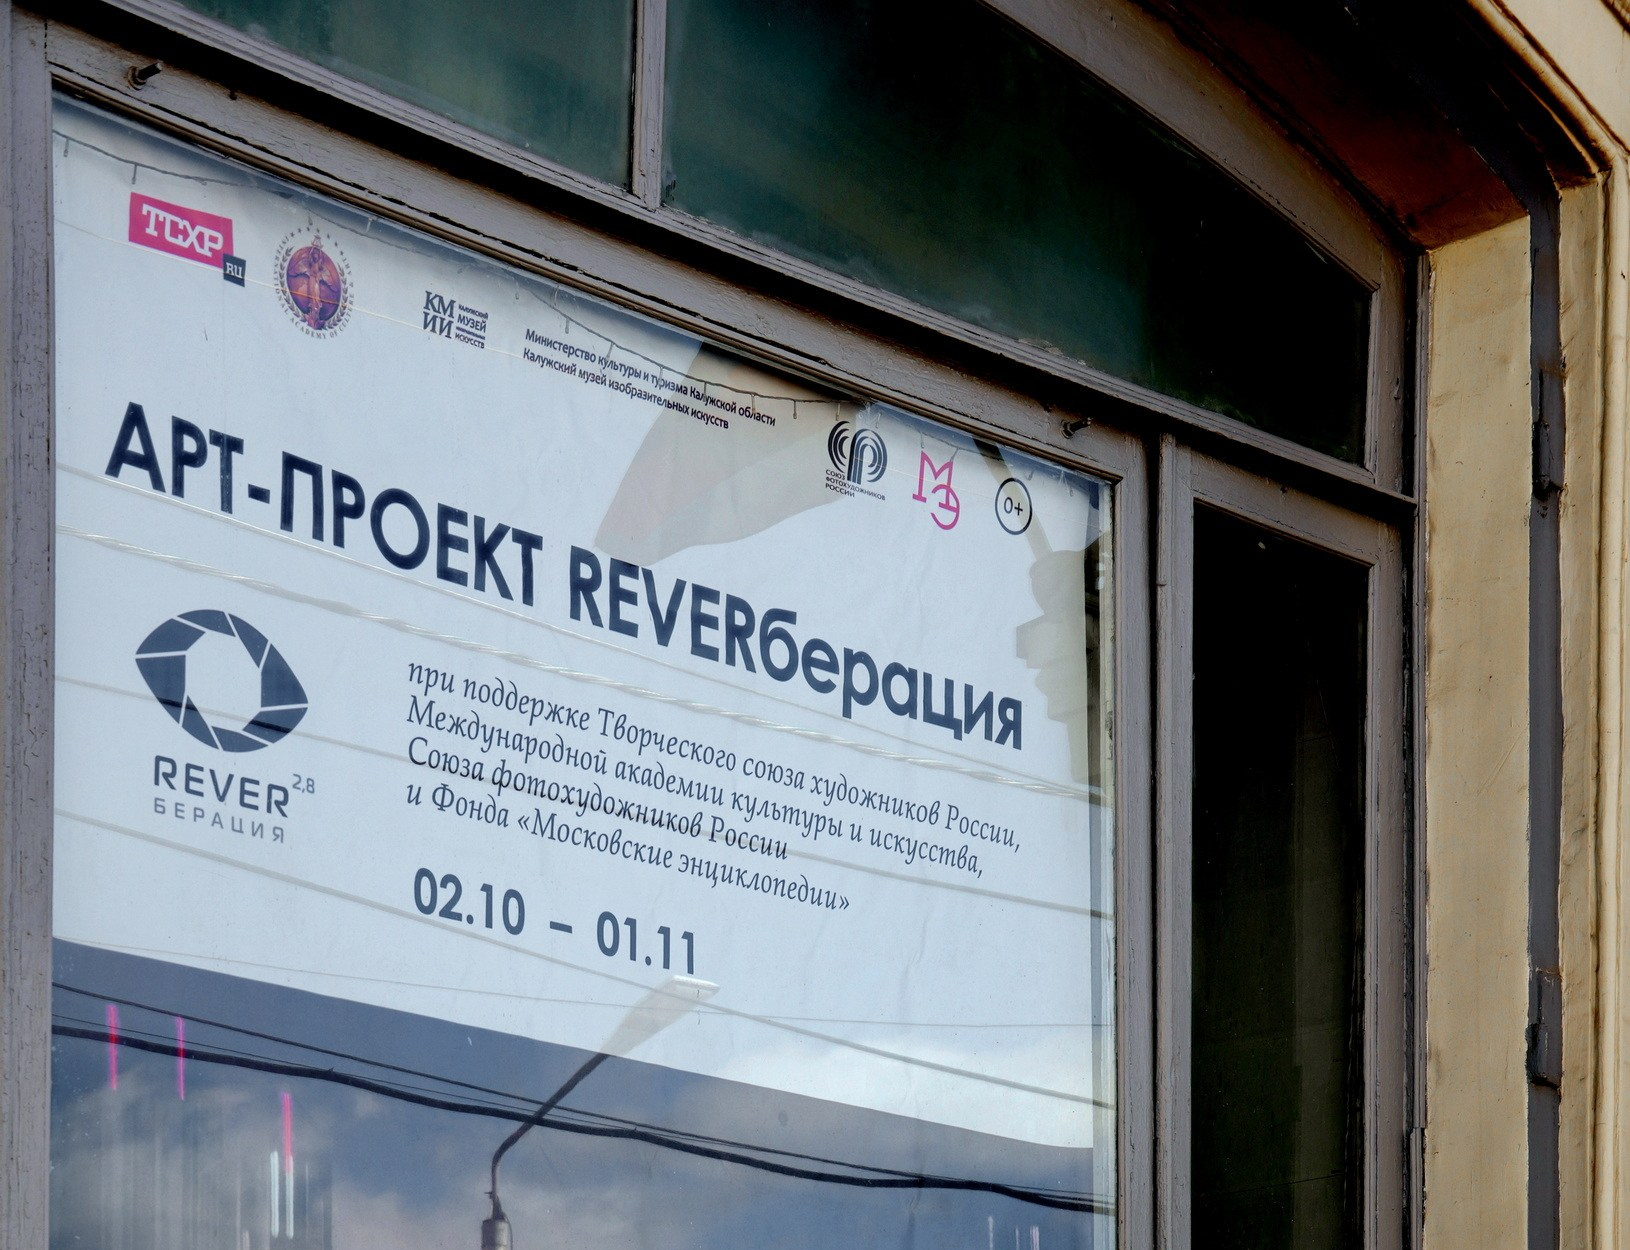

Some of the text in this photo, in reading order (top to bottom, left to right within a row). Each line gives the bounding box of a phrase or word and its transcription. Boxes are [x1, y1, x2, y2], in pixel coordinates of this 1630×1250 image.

[226, 262, 242, 279] RU
[423, 290, 456, 319] КМ
[457, 314, 487, 333] МУЗЕЙ
[289, 317, 327, 340] ACADEMY
[423, 311, 454, 339] ИИ
[455, 332, 485, 349] ИСКУССТВ
[523, 347, 729, 430] Калужский музей изобразительных искусств
[525, 328, 776, 427] Министерство культуры и туризма Калужской области
[825, 469, 846, 481] СОЮЗ
[825, 476, 886, 501] ФОТОХУДОЖНИКОВ
[825, 483, 855, 497] РОССИИ
[1003, 496, 1024, 517] 0+
[104, 401, 1022, 750] АРТ-ПРОЕКТ REVERберация
[408, 662, 1021, 853] при поддержке Творческого союза художников России,
[154, 755, 315, 818] REVER 2,8
[406, 695, 984, 878] Международной академии культуры и искусства,
[408, 736, 788, 860] Союза фотохудожников России
[154, 797, 285, 844] БЕРАЦИЯ
[406, 783, 850, 911] и Фонда «Московские энциклопедии»
[414, 867, 526, 935] 02.10
[596, 911, 694, 975] 01.11
